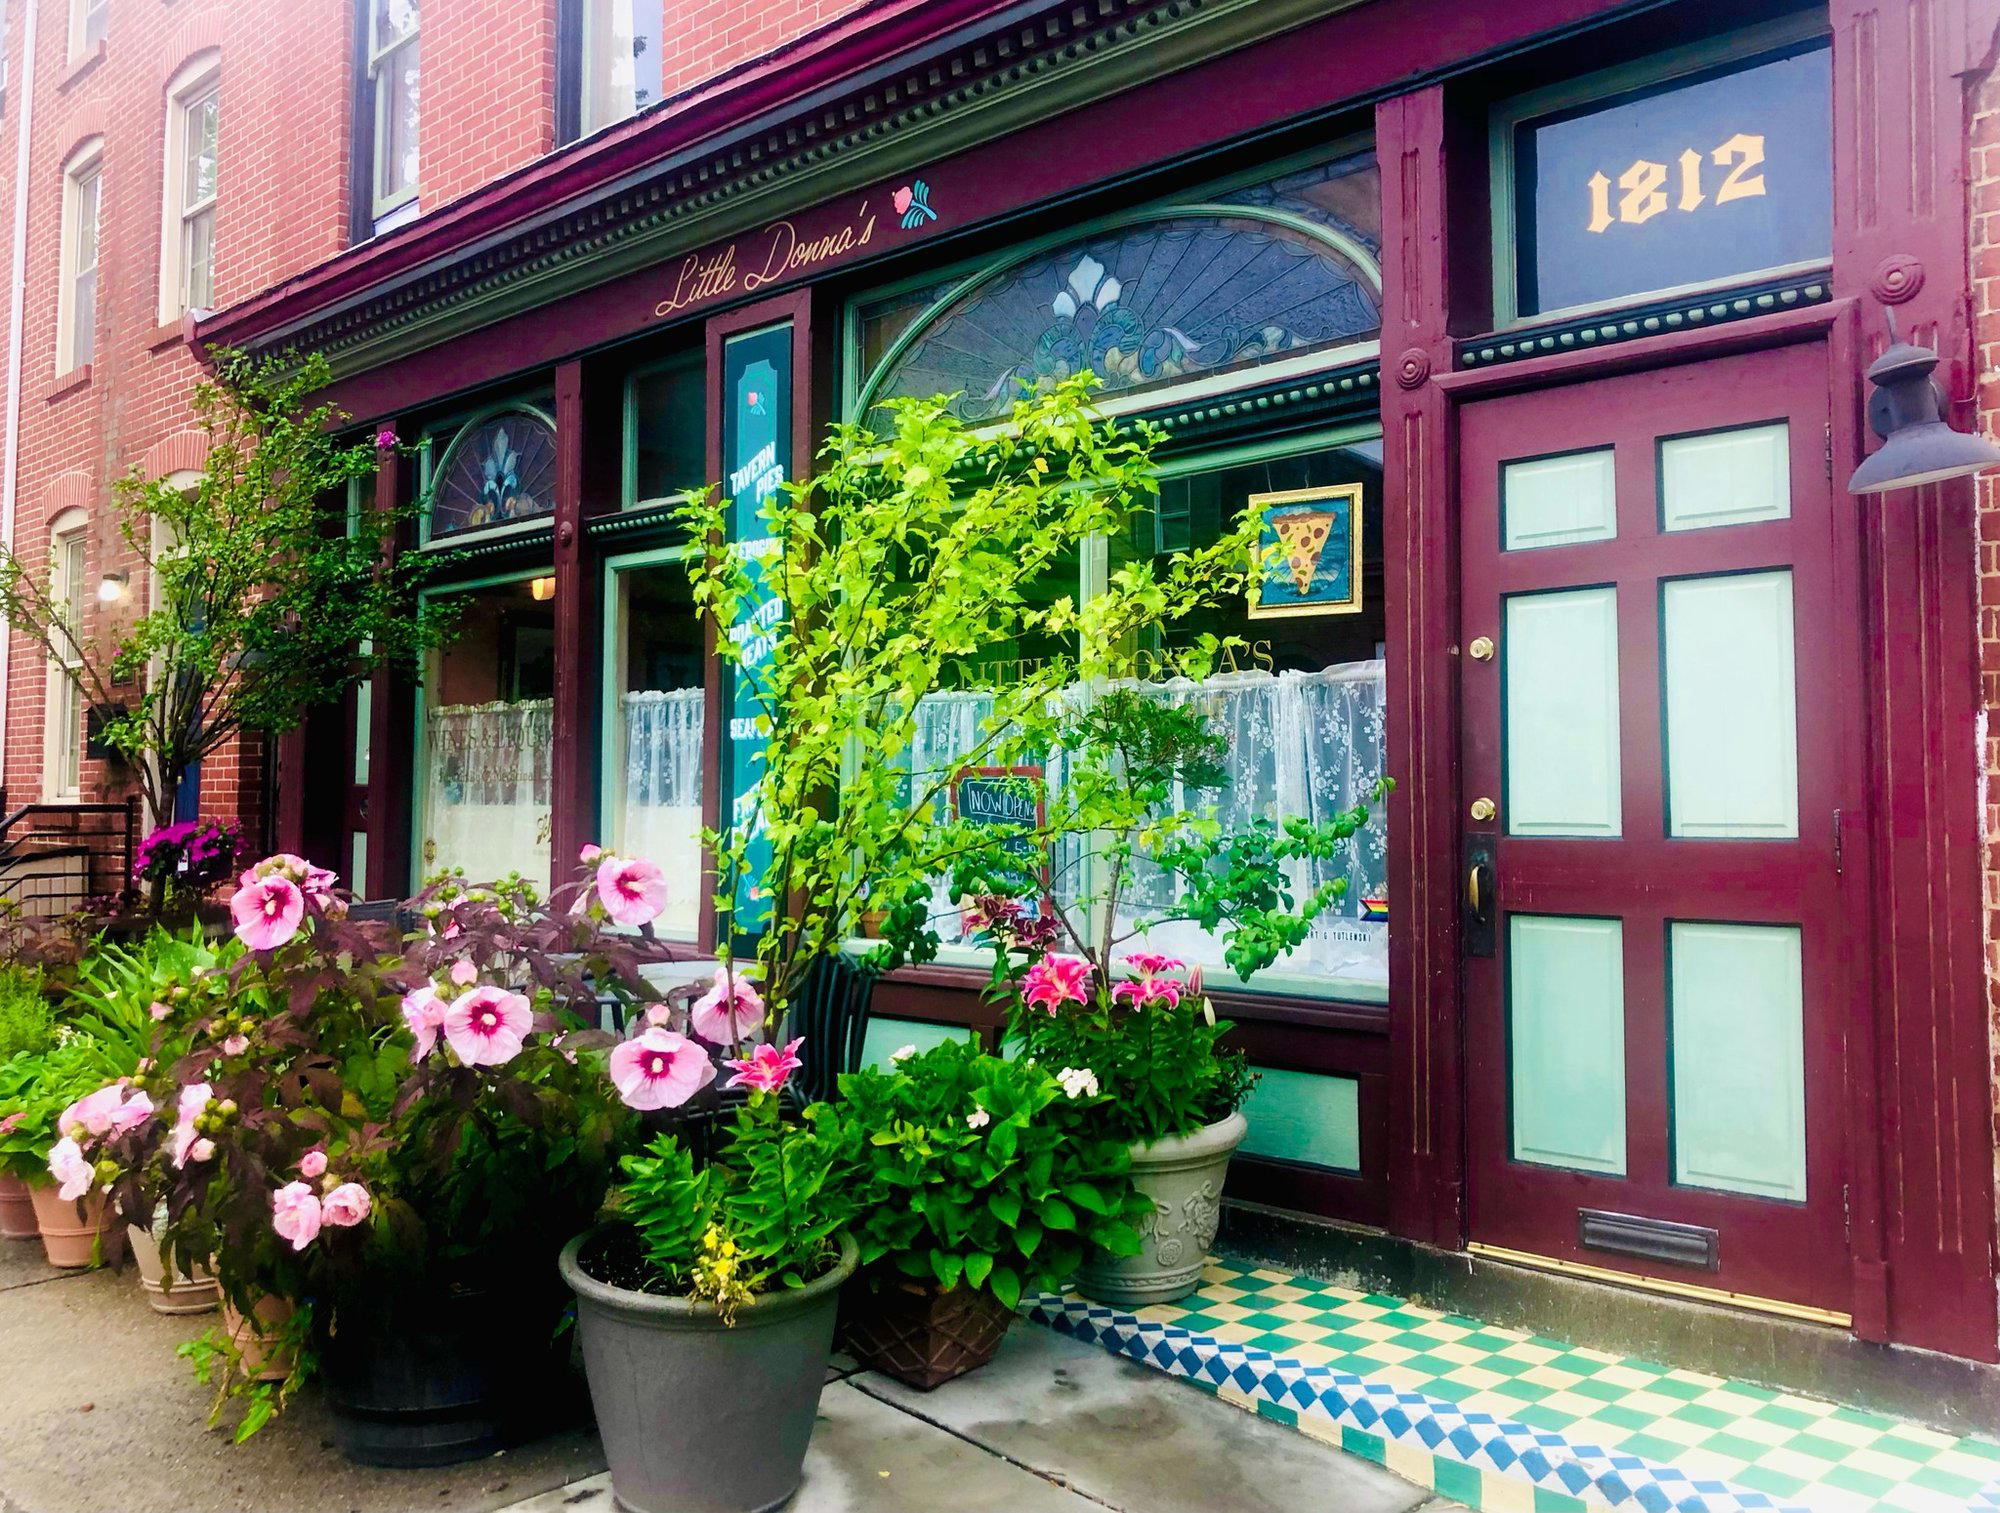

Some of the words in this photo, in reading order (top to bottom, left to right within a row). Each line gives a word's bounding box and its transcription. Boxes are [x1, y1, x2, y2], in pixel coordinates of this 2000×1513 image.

[1586, 133, 1766, 234] 1812
[654, 243, 737, 317] Little
[743, 199, 878, 291] Donna's
[729, 440, 776, 497] TAVERN
[755, 464, 784, 504] PIES
[728, 596, 784, 643] ROATED
[970, 790, 1002, 813] NOW
[1002, 793, 1032, 819] OPEN
